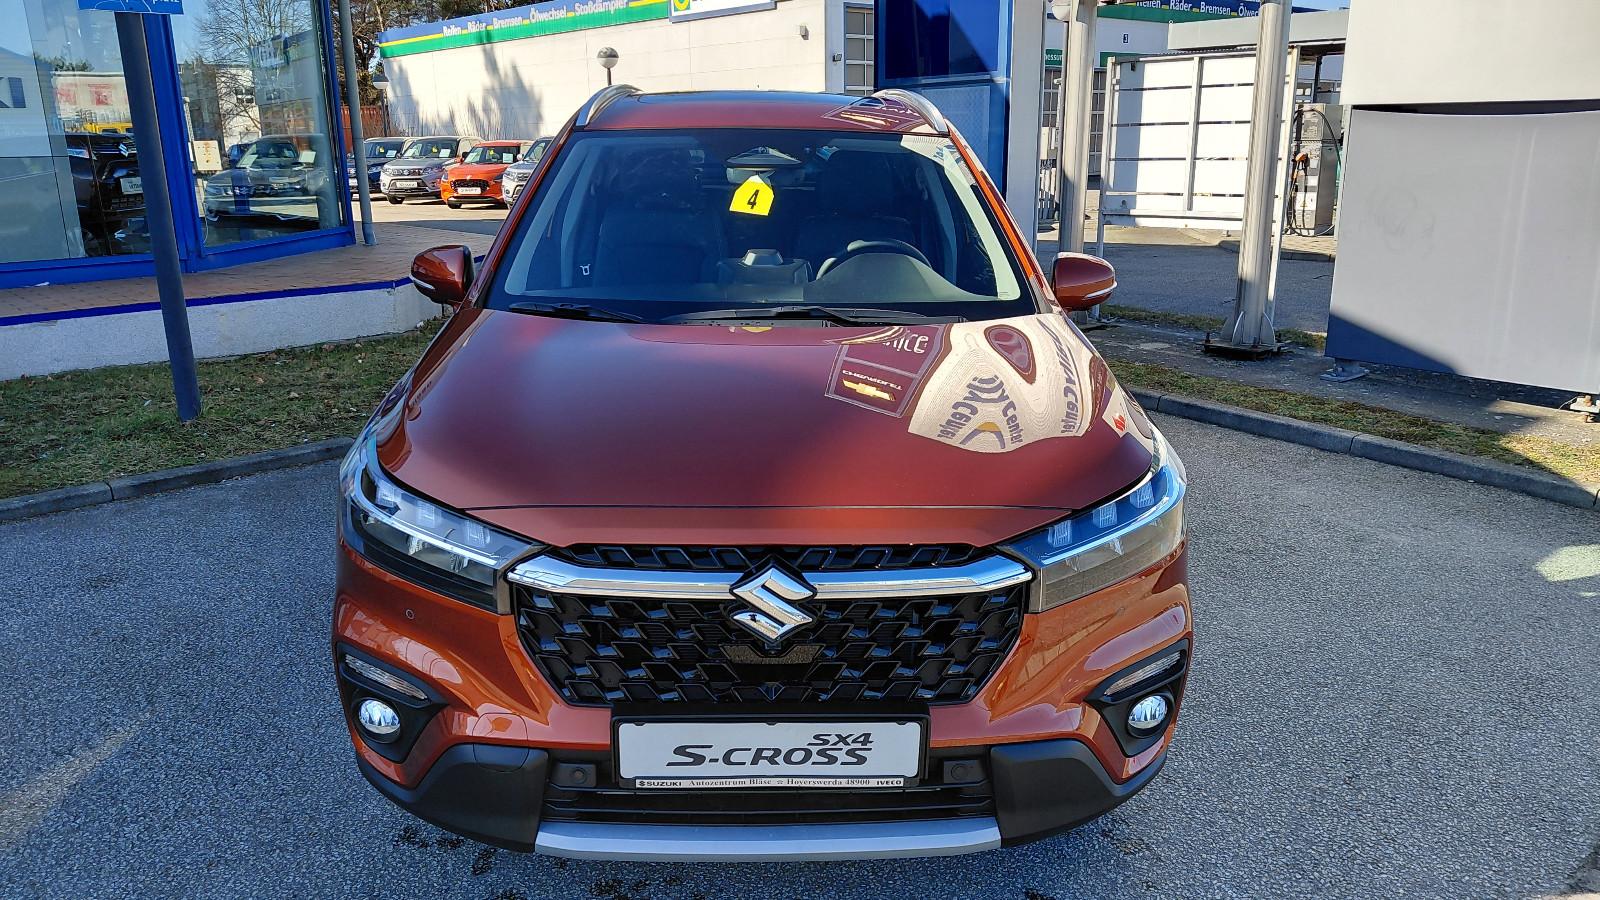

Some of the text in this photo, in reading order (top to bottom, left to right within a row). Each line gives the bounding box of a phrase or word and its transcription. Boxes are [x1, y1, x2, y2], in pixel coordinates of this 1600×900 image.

[1169, 0, 1192, 12] Räder
[1200, 1, 1231, 15] Bremsen
[442, 0, 628, 37] Reifen Räder Bremsen Ölwechsel Stoßdämpfer
[747, 189, 760, 210] 4
[808, 732, 874, 747] SX4
[665, 744, 873, 767] S-CROSS
[688, 779, 746, 787] Autozentrum
[749, 778, 772, 786] Bläse
